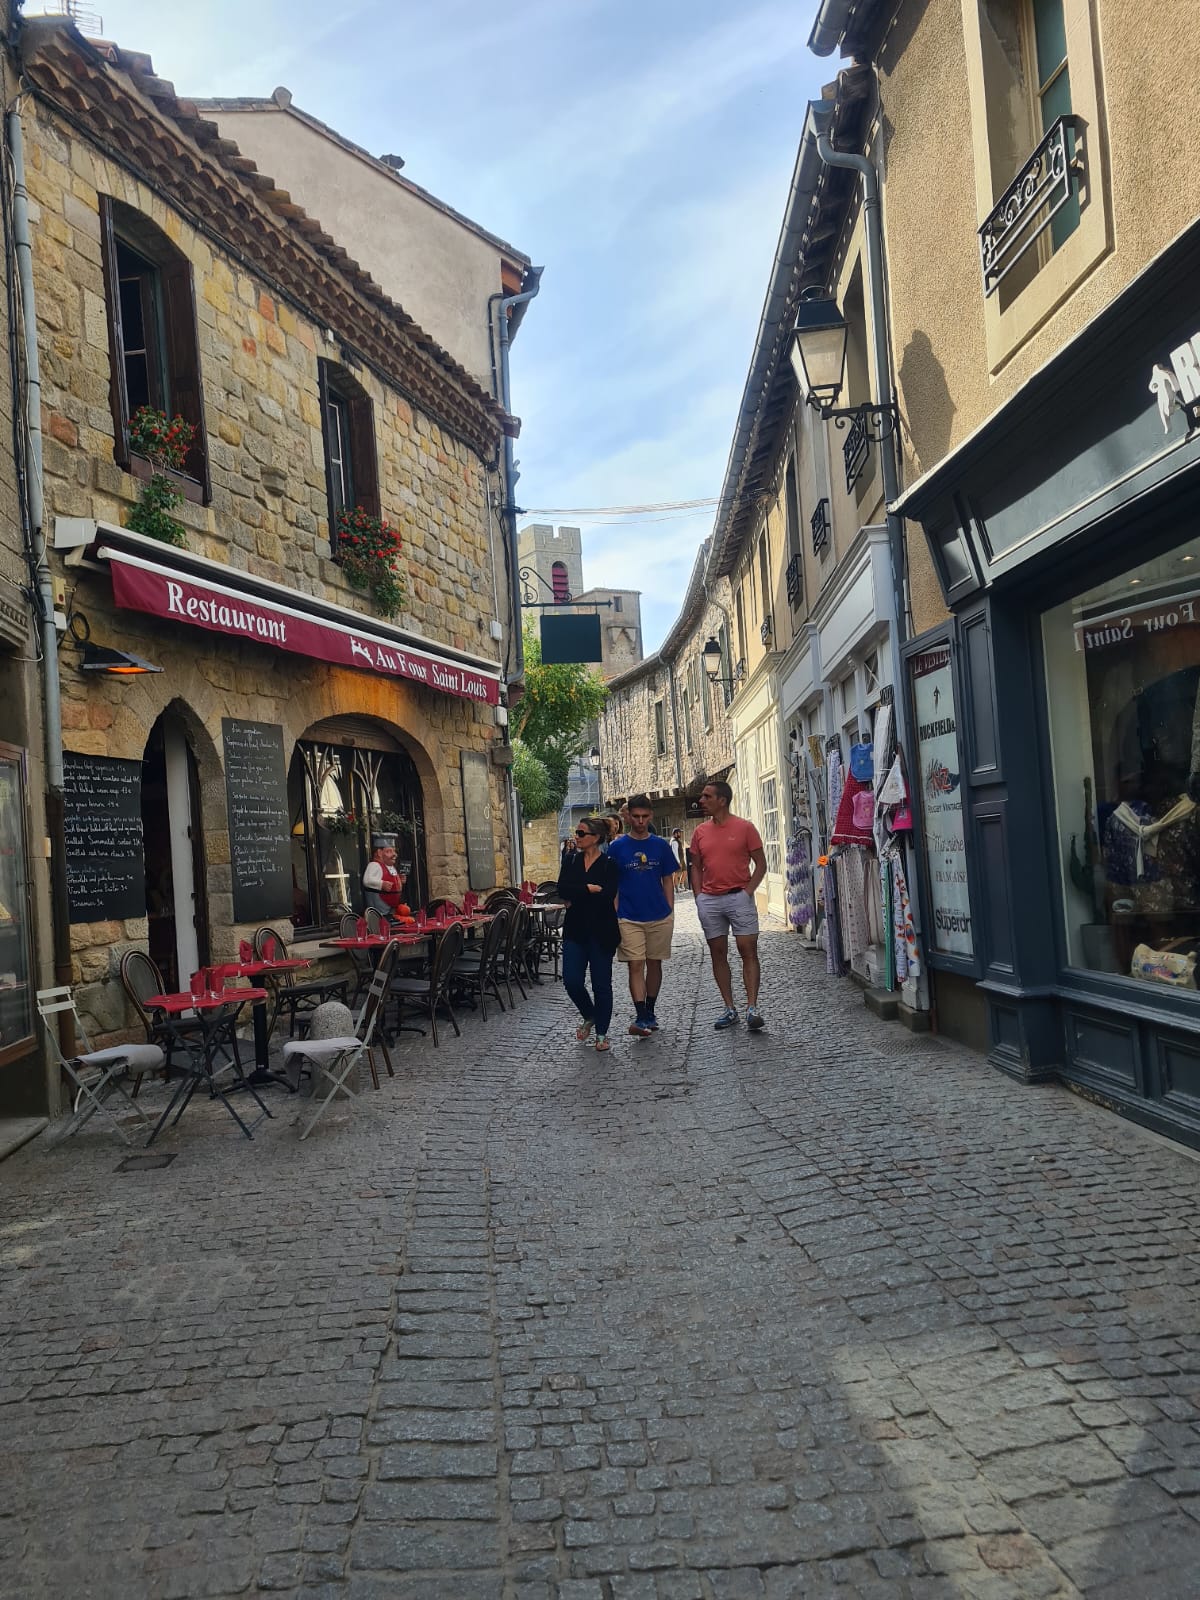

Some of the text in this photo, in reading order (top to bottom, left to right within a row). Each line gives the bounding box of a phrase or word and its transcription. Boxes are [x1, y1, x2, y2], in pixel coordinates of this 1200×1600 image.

[166, 581, 487, 697] Restaurant Au Four Saint Louis
[935, 908, 972, 937] Superdr
